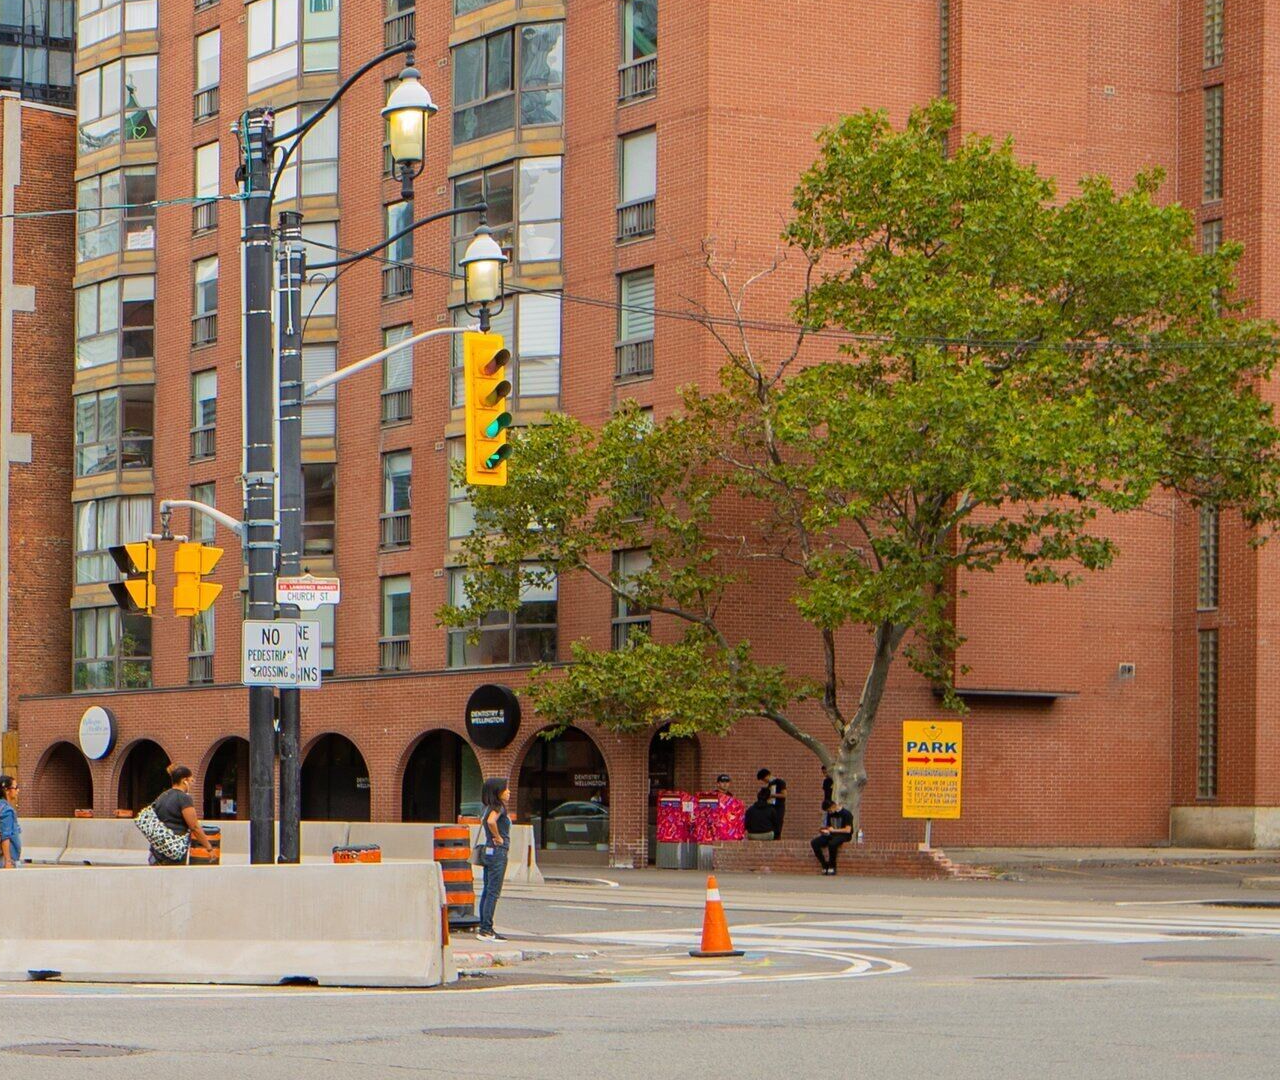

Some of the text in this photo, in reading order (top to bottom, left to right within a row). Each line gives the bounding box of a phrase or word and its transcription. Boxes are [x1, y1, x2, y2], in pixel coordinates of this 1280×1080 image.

[287, 592, 328, 601] CHURCH ST
[262, 628, 280, 645] NO
[298, 626, 309, 640] NE
[248, 649, 292, 662] PEDESTRIA
[297, 646, 309, 660] AY
[470, 710, 499, 718] DENTISTRY
[907, 742, 957, 753] PARK
